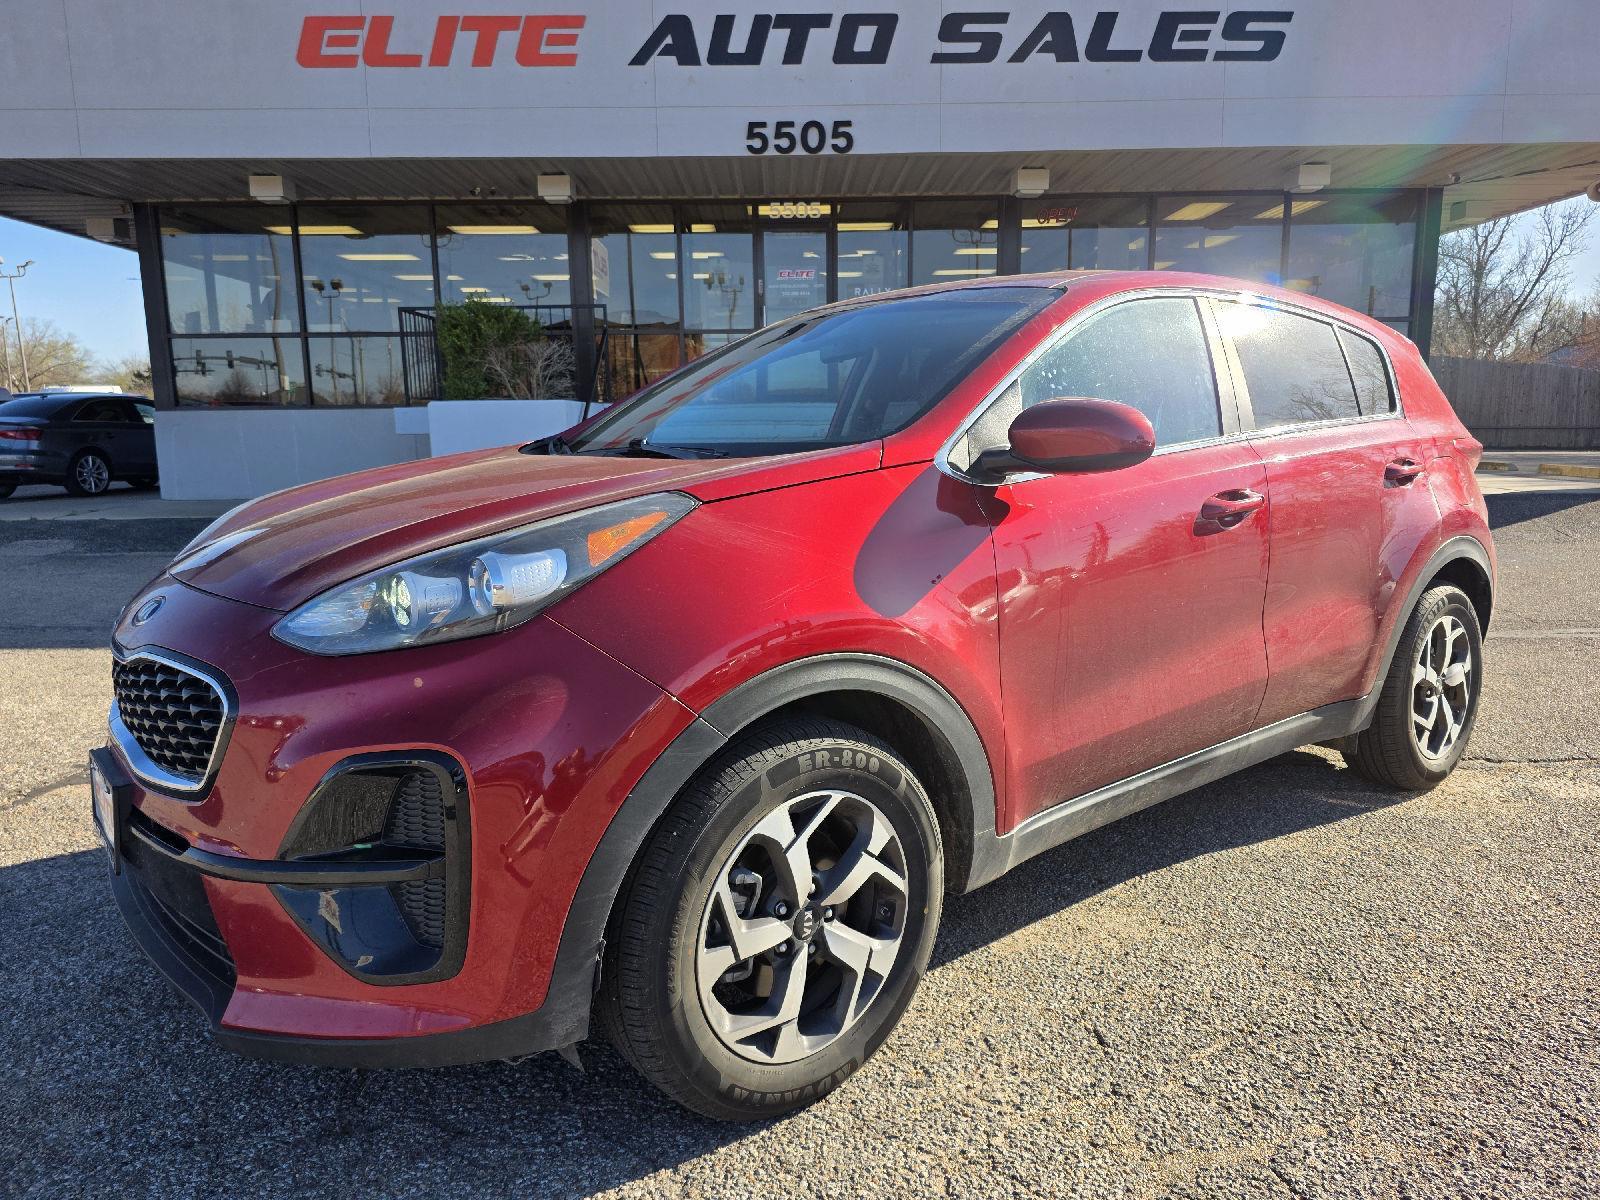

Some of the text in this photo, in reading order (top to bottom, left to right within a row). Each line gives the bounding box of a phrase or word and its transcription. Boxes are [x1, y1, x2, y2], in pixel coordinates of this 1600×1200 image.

[296, 10, 1294, 68] ELITE AUTO SALES
[745, 120, 854, 154] 5505
[769, 202, 822, 219] 5505
[1037, 207, 1078, 224] OPEN
[778, 268, 816, 278] ELITE
[798, 749, 880, 774] ER-800
[801, 910, 813, 938] KIA
